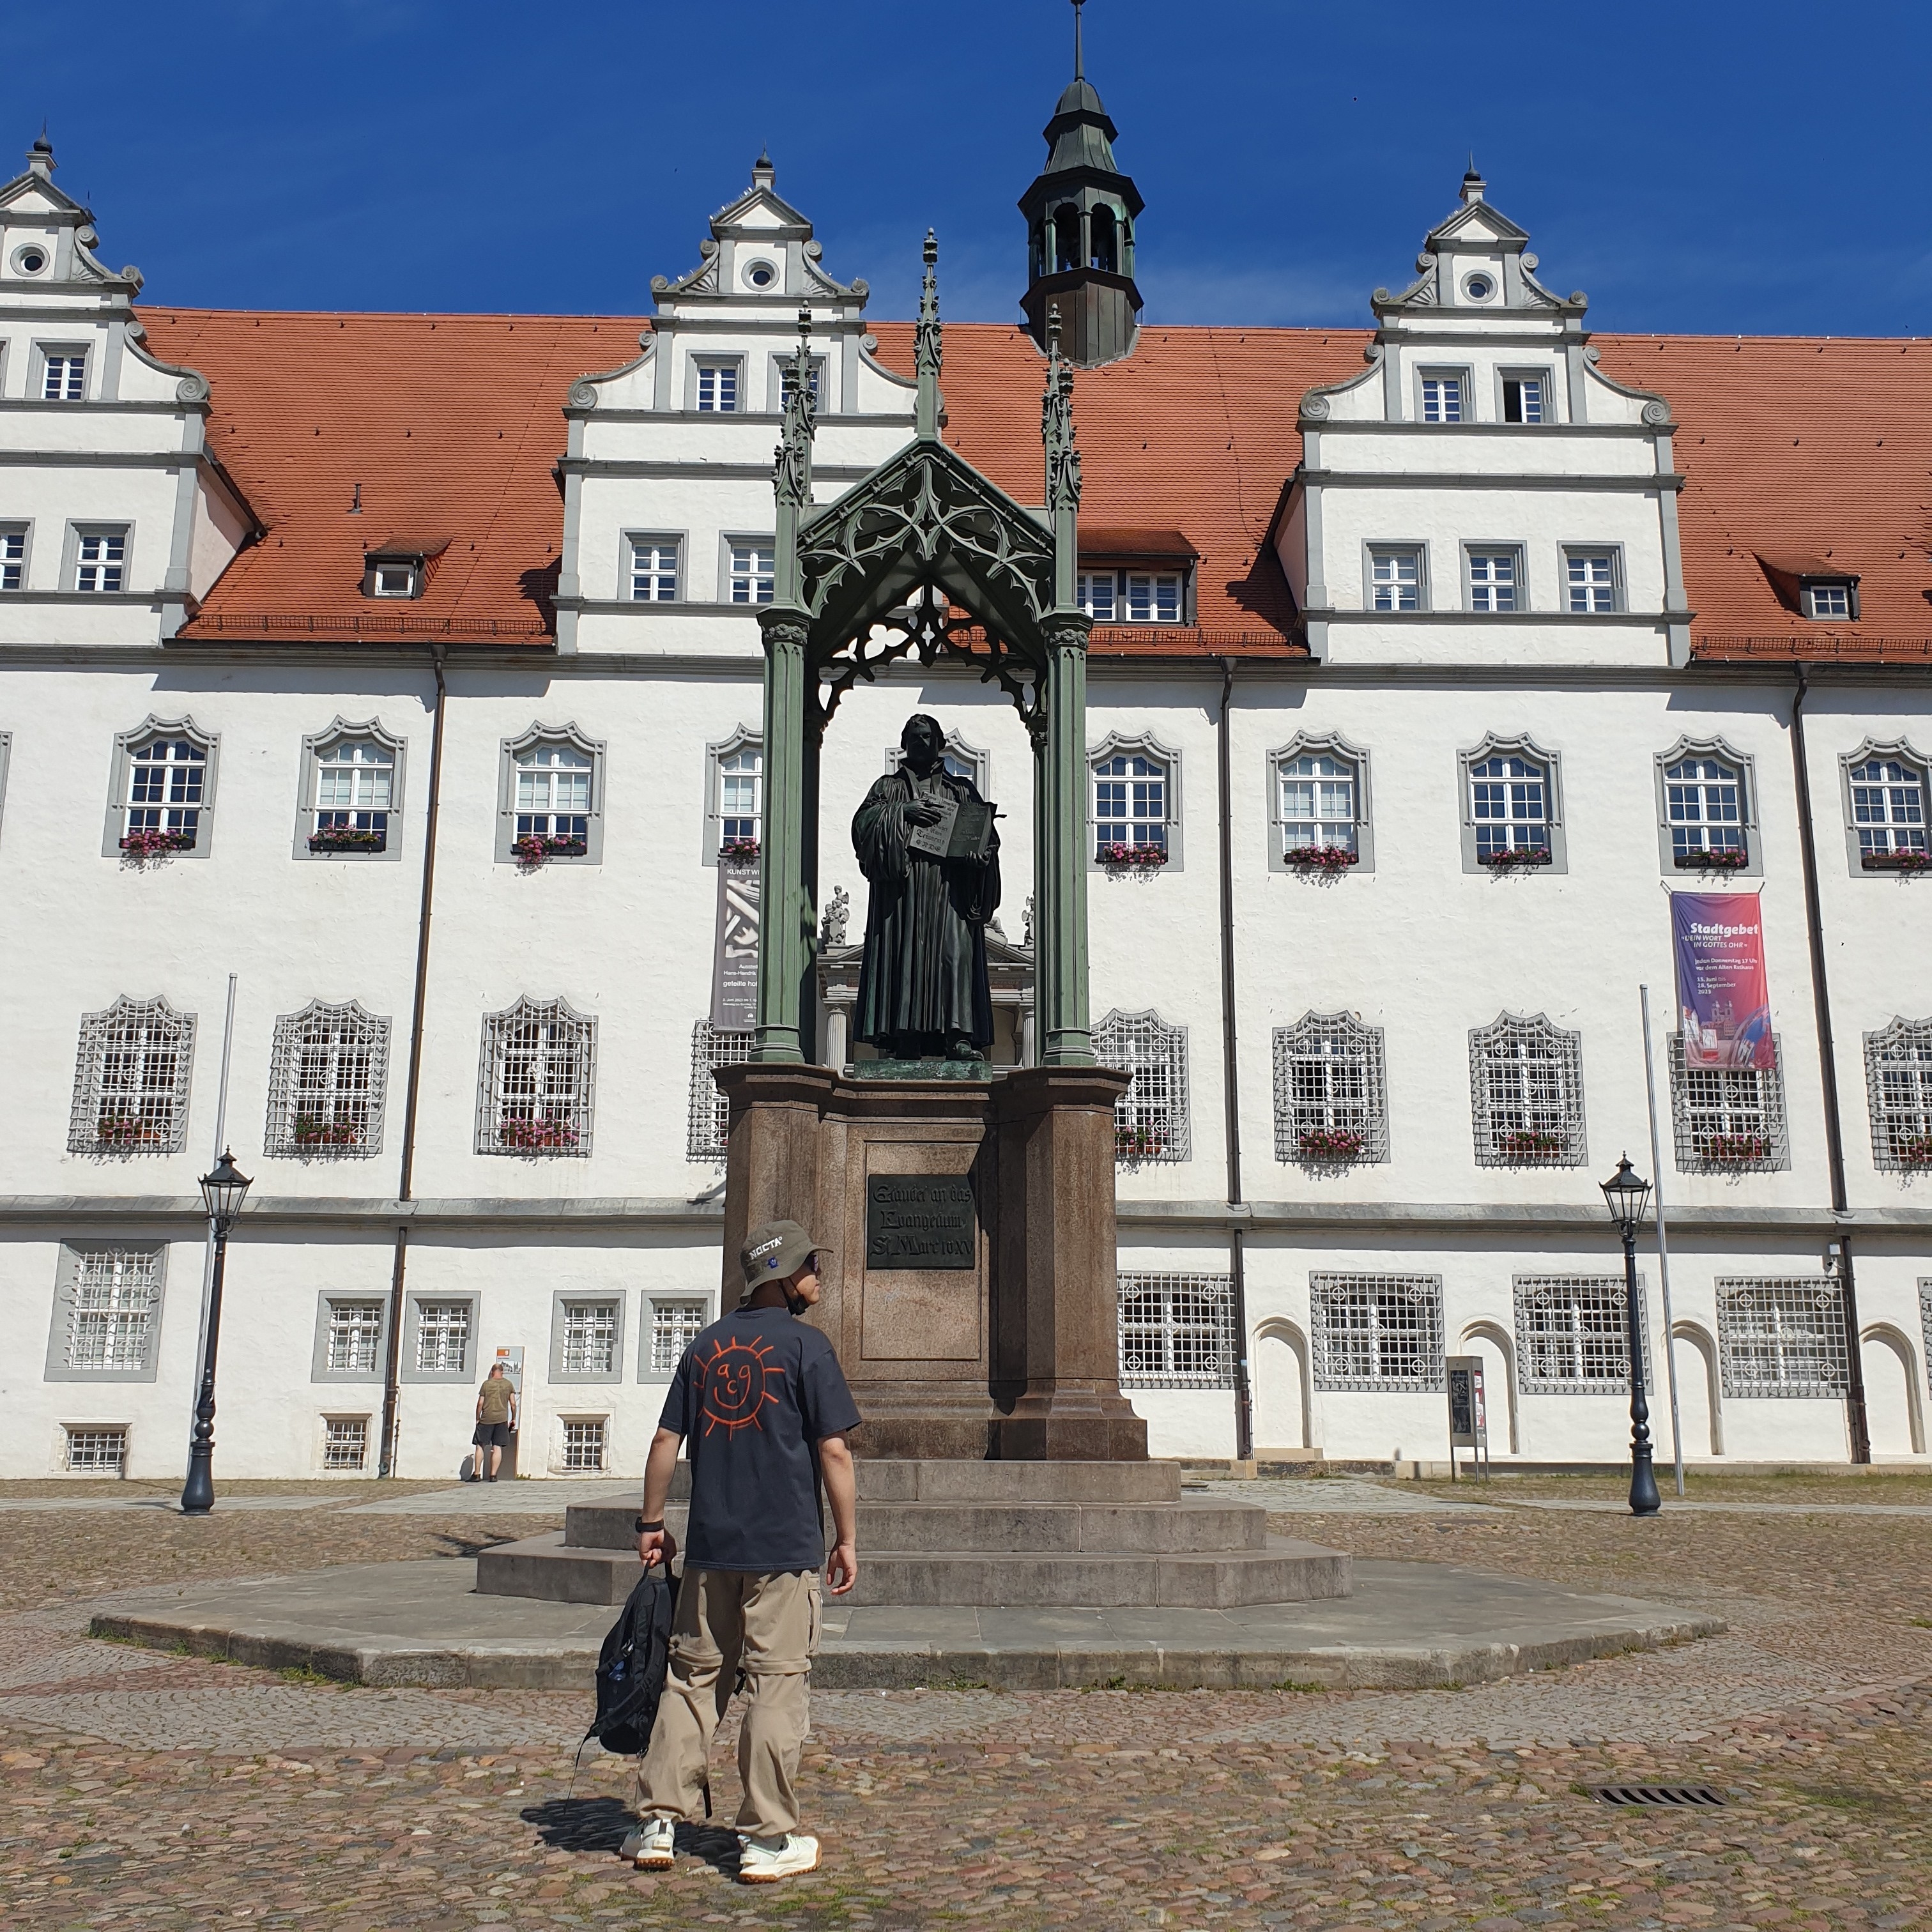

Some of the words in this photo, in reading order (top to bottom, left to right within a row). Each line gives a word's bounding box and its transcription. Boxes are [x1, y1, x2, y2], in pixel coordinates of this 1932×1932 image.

[1690, 923, 1758, 938] Stadtgebet
[931, 1188, 946, 1202] an
[950, 1184, 971, 1202] das
[749, 1237, 783, 1260] NOCTA
